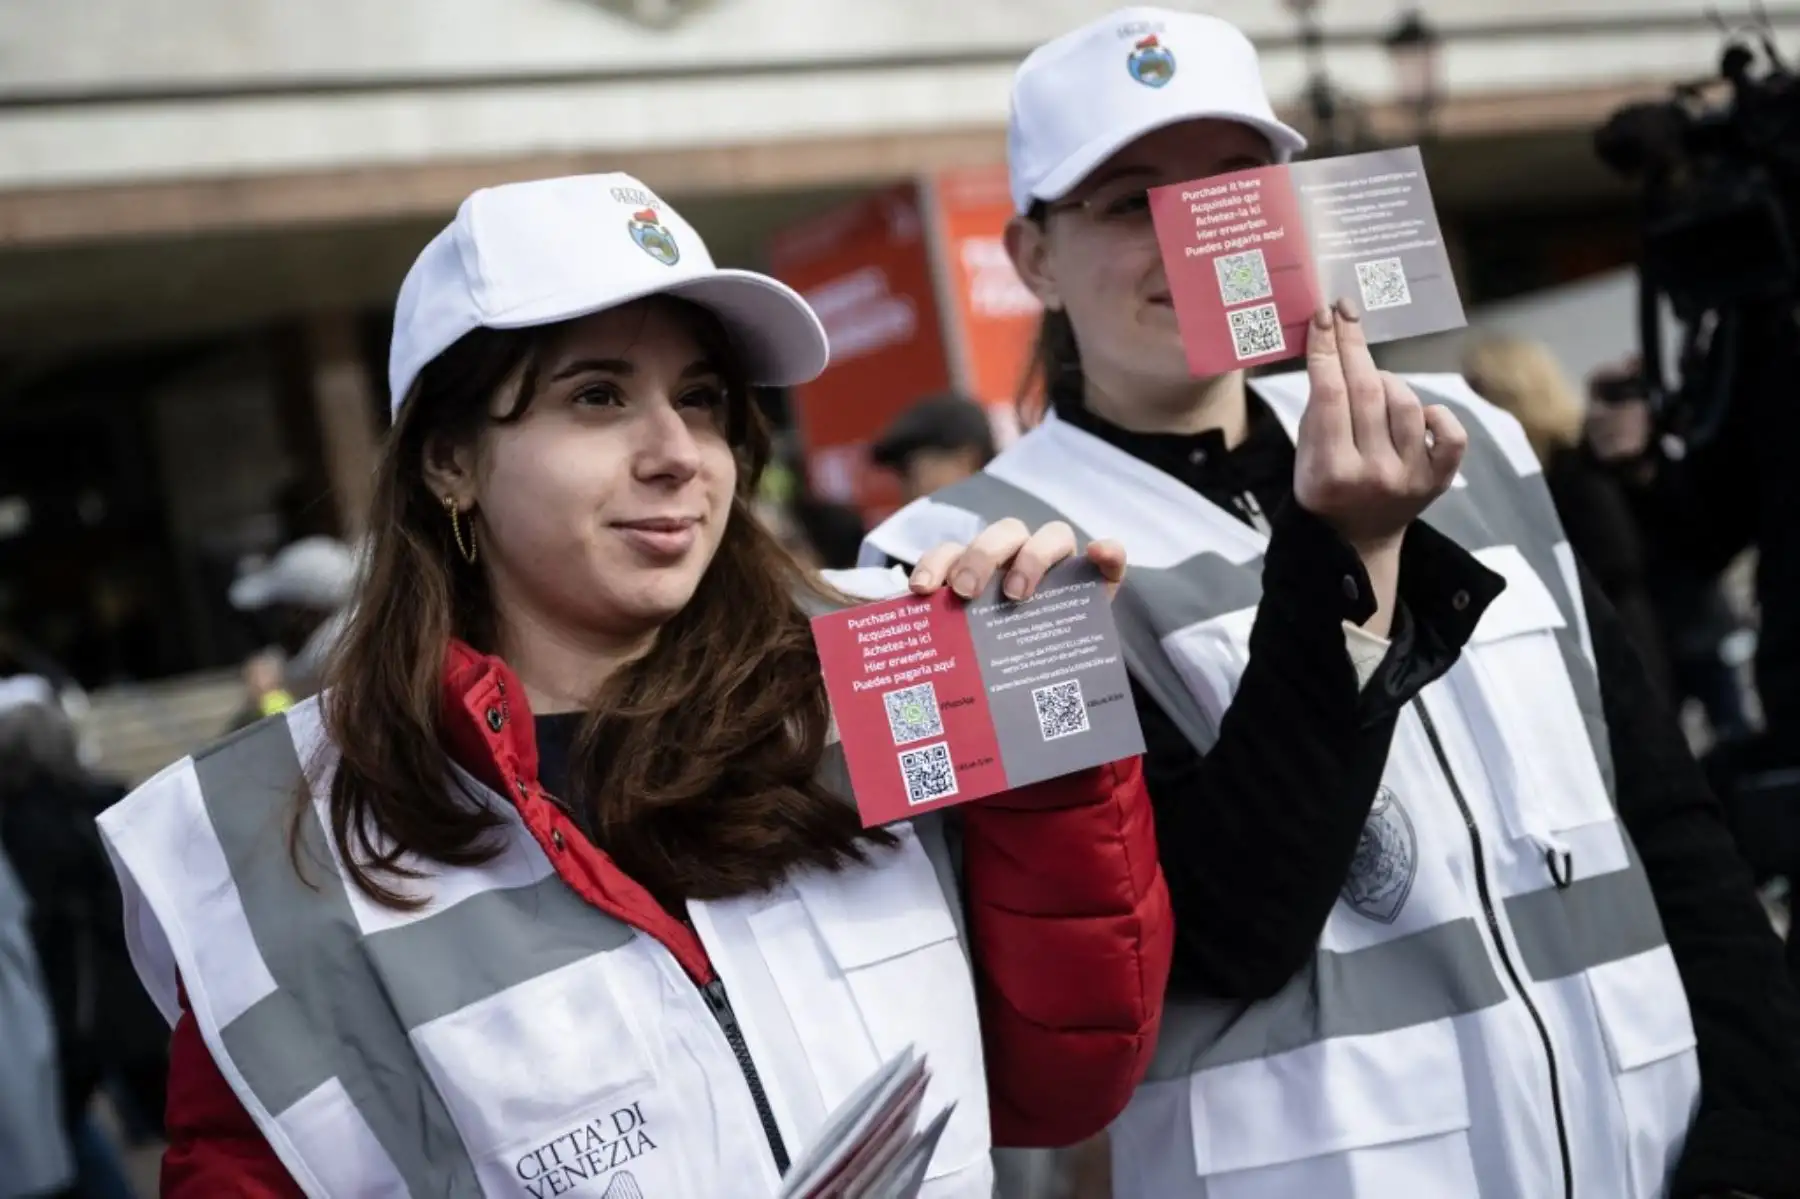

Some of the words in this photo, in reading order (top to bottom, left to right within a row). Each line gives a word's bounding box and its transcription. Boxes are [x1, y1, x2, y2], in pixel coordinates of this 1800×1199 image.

[1182, 184, 1227, 202] Purchase
[1238, 178, 1261, 190] here
[1191, 195, 1242, 214] Acquistalo
[1185, 241, 1222, 257] Puedes
[848, 610, 897, 630] Purchase
[907, 602, 931, 615] here
[858, 624, 911, 644] Acquistalo
[913, 617, 930, 631] qui
[863, 638, 918, 658] Achetez-la
[919, 632, 932, 645] ici
[864, 660, 887, 673] Hier
[888, 648, 938, 667] erwerben
[852, 674, 892, 692] Puedes
[610, 1101, 647, 1136] DI
[525, 1130, 657, 1199] VENEZIA
